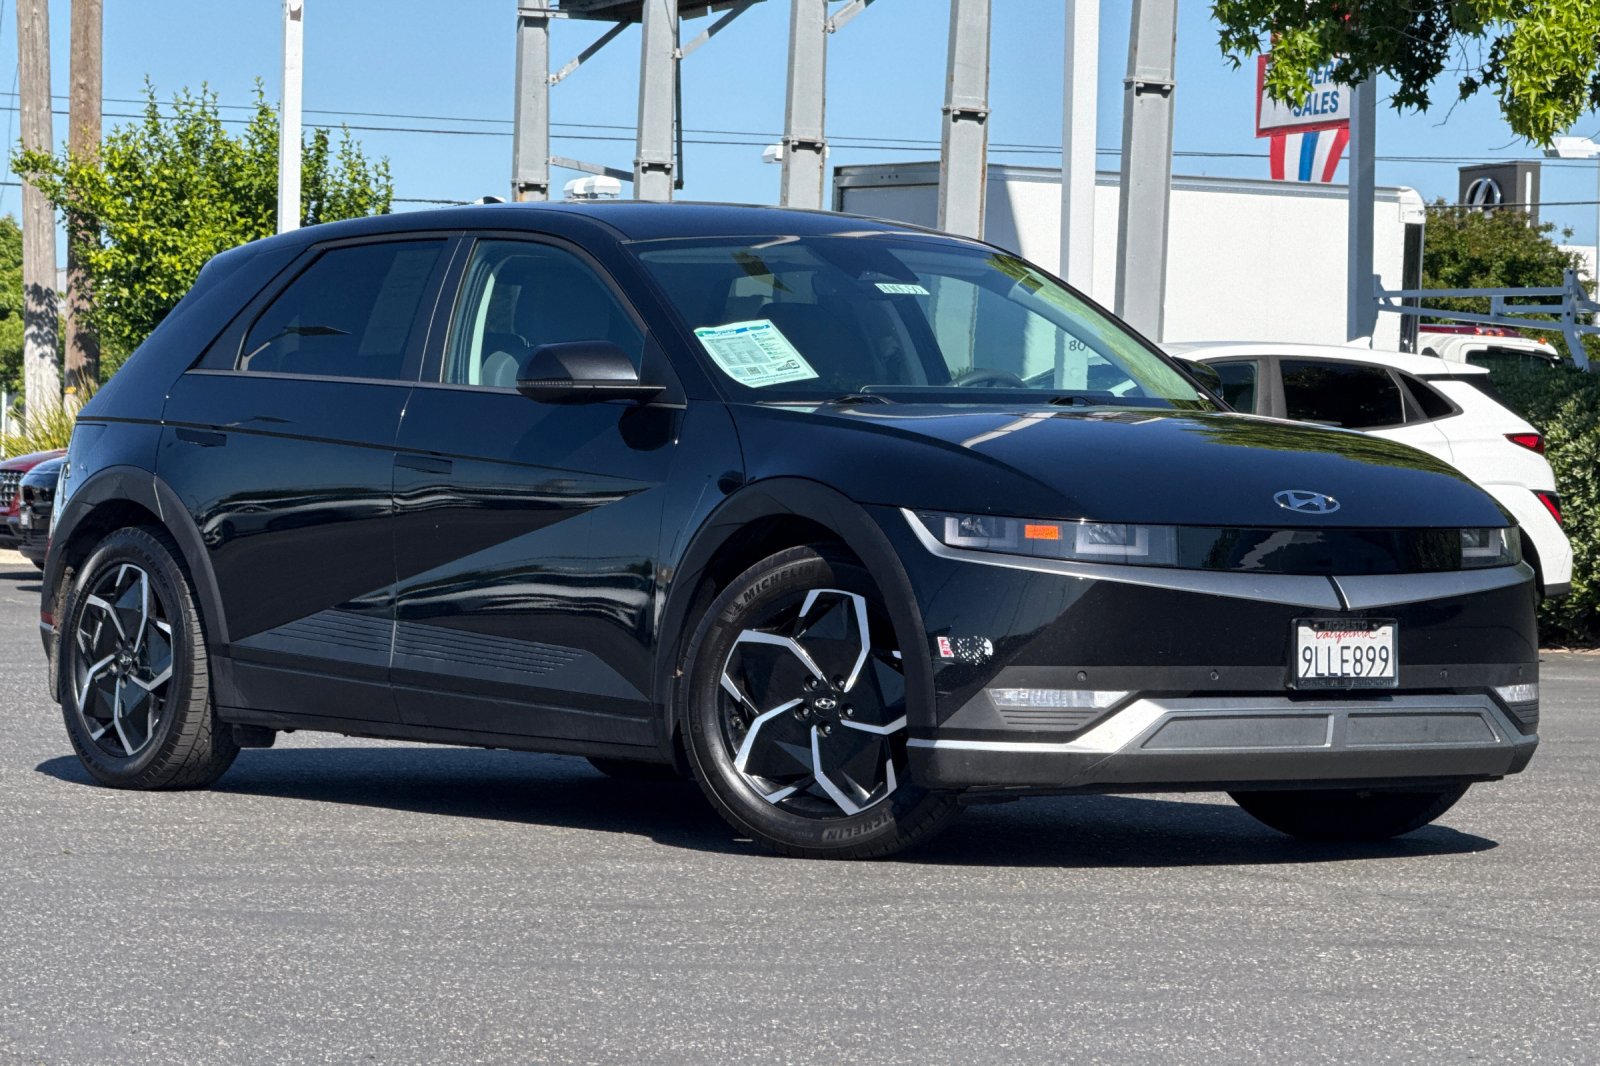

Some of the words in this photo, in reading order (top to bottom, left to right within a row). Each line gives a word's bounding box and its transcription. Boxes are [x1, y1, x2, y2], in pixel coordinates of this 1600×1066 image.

[1293, 90, 1339, 117] SALES
[743, 564, 816, 603] MICHELIN
[1302, 645, 1389, 677] 9LLE899
